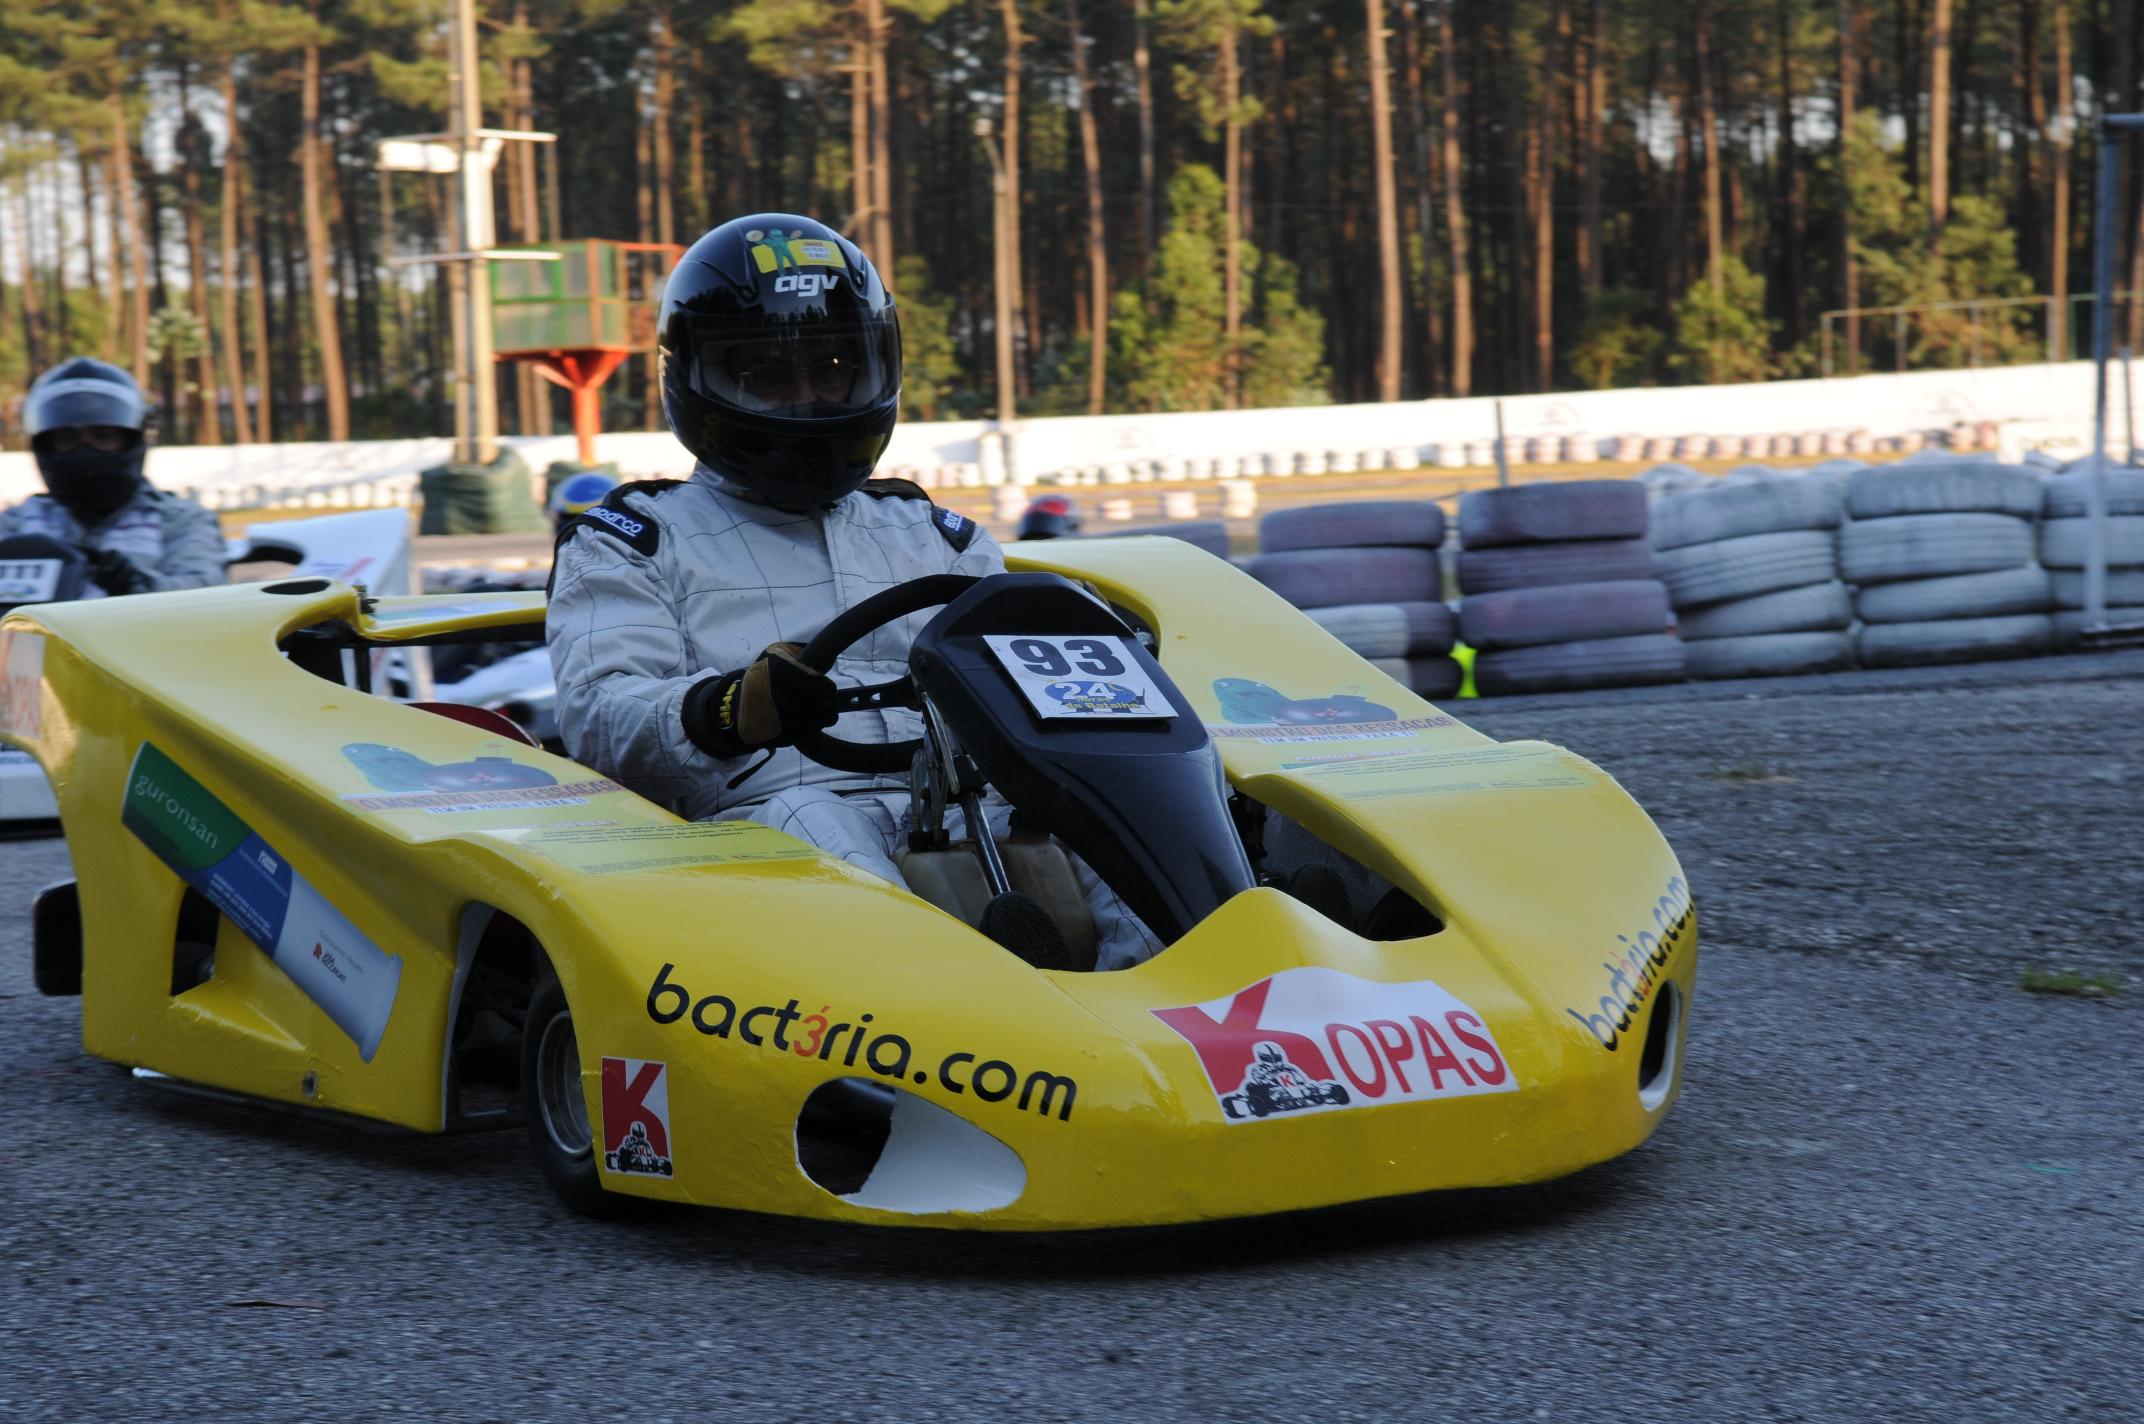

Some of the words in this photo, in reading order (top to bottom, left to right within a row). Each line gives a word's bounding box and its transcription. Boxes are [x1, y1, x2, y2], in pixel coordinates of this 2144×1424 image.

[774, 274, 840, 298] agv
[1009, 639, 1127, 677] 93
[1054, 682, 1117, 700] 24
[1352, 717, 1453, 734] RESSACAS
[517, 780, 623, 801] RESSACAS
[133, 775, 220, 850] guronsan
[602, 1058, 669, 1158] K
